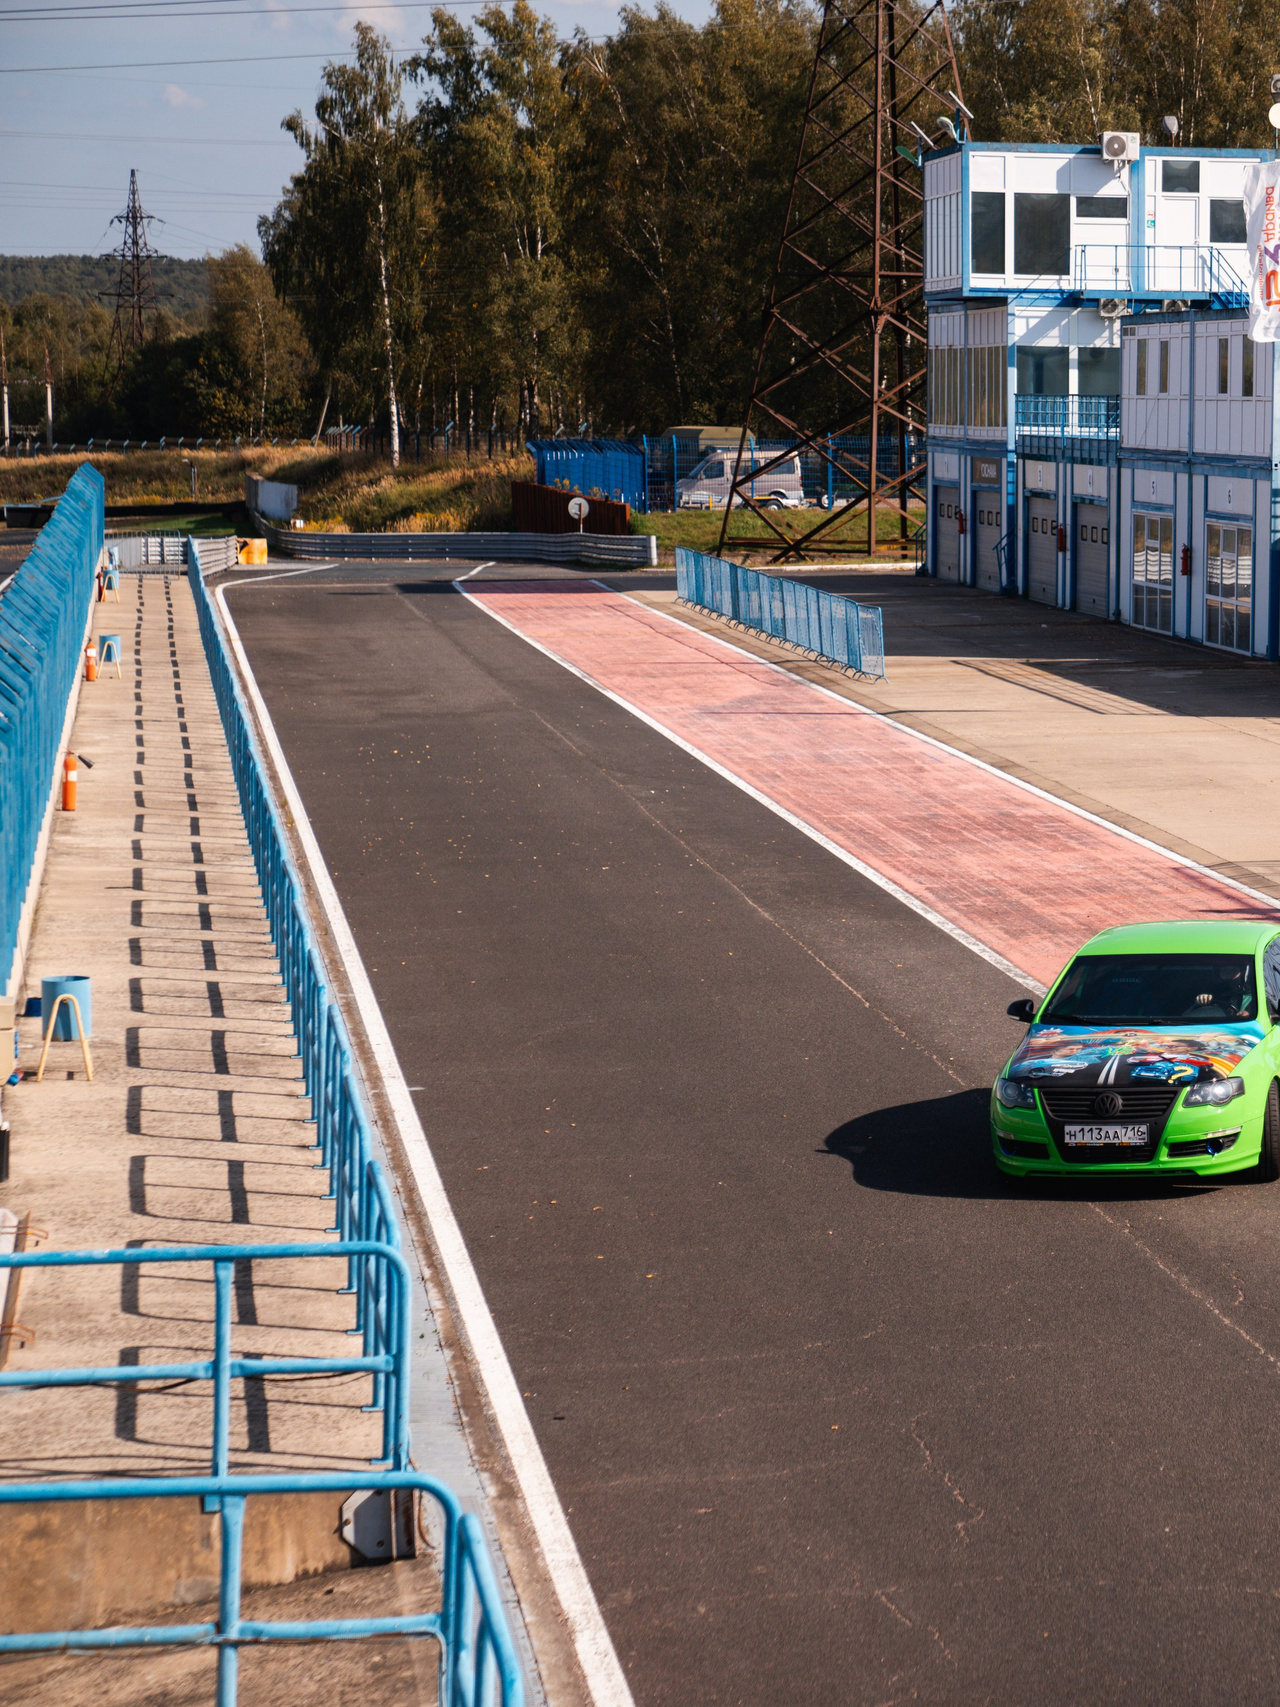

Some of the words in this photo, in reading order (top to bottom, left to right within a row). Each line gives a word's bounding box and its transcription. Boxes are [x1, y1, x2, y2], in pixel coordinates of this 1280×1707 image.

[1151, 480, 1155, 495] 5
[1228, 489, 1232, 504] 6
[1122, 1126, 1142, 1137] 716
